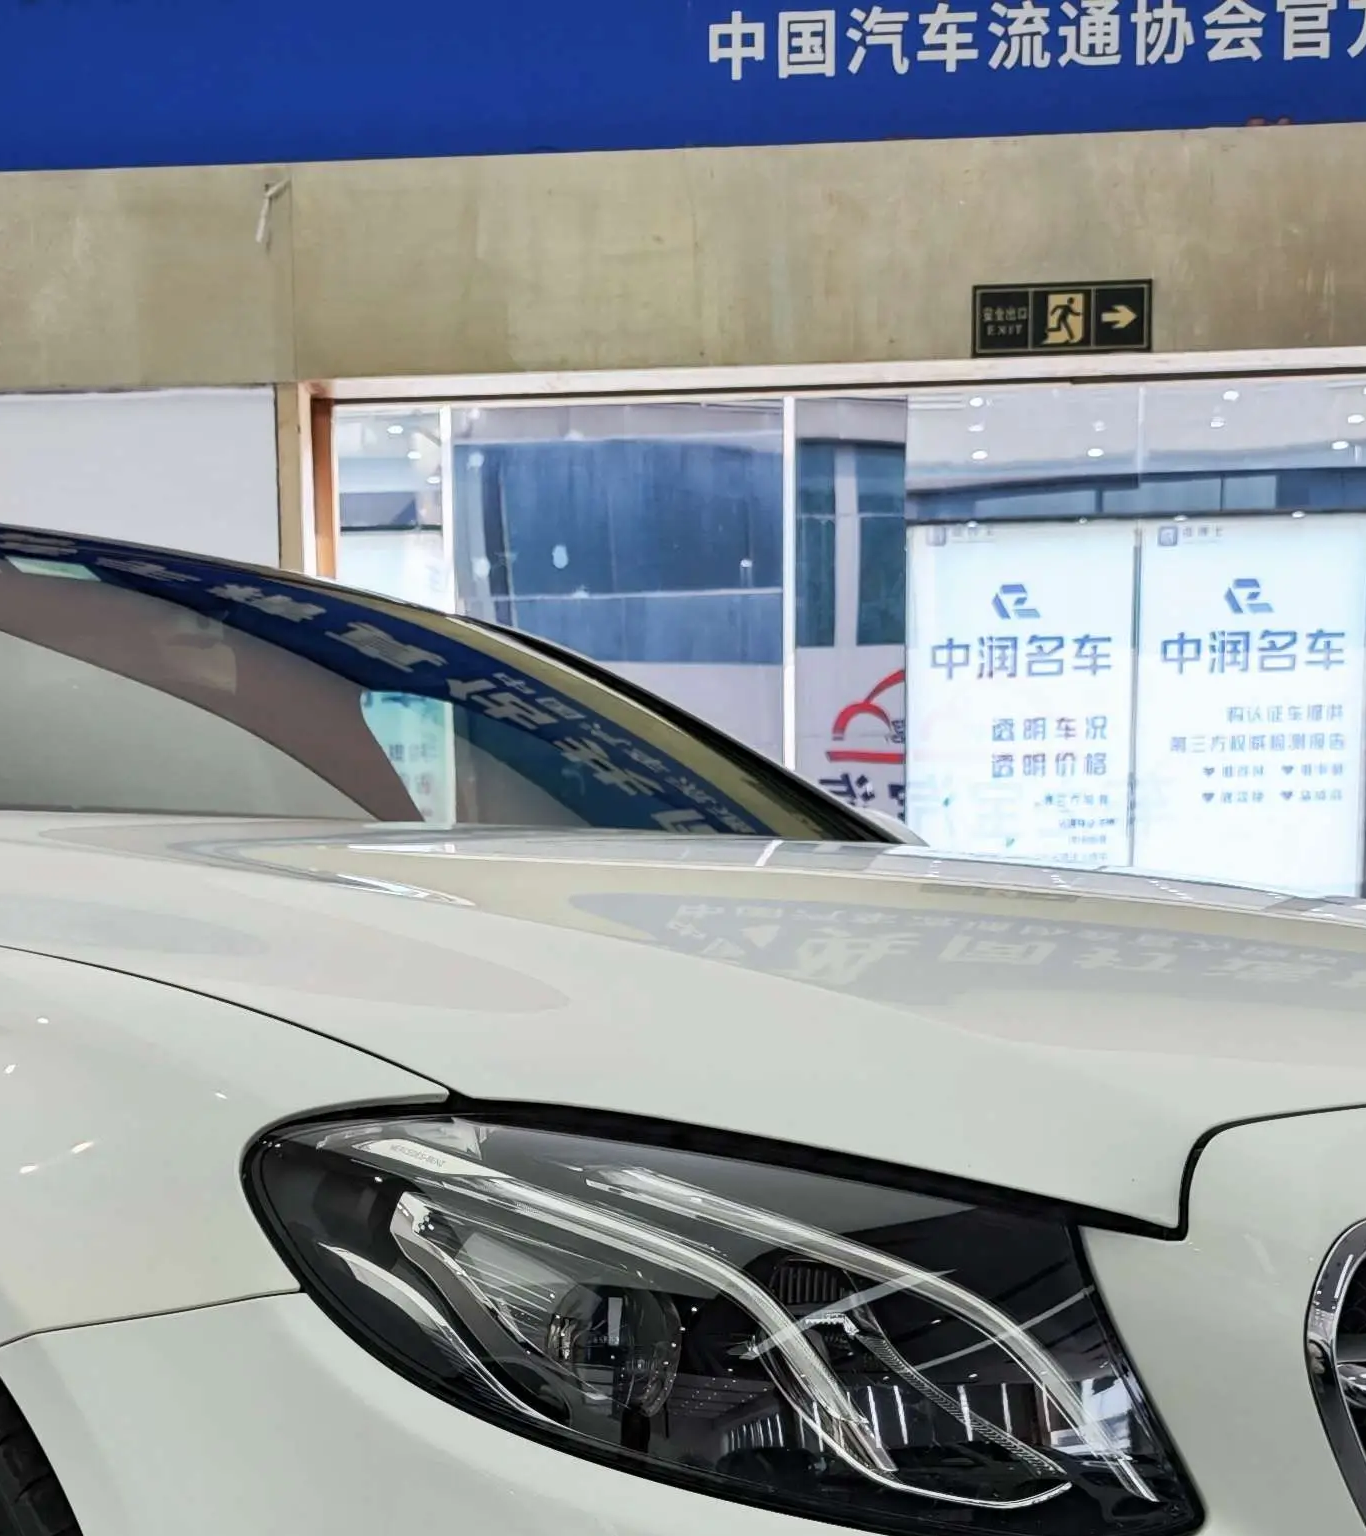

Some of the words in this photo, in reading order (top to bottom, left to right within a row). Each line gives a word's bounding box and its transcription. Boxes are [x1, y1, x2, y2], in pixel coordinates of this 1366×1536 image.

[982, 305, 1028, 322] 安全出口
[986, 324, 1023, 337] EXIT
[930, 633, 1113, 681] 中润名车
[1160, 628, 1346, 675] 中润名车
[991, 715, 1108, 742] 透明车况
[991, 752, 1108, 779] 透明价格
